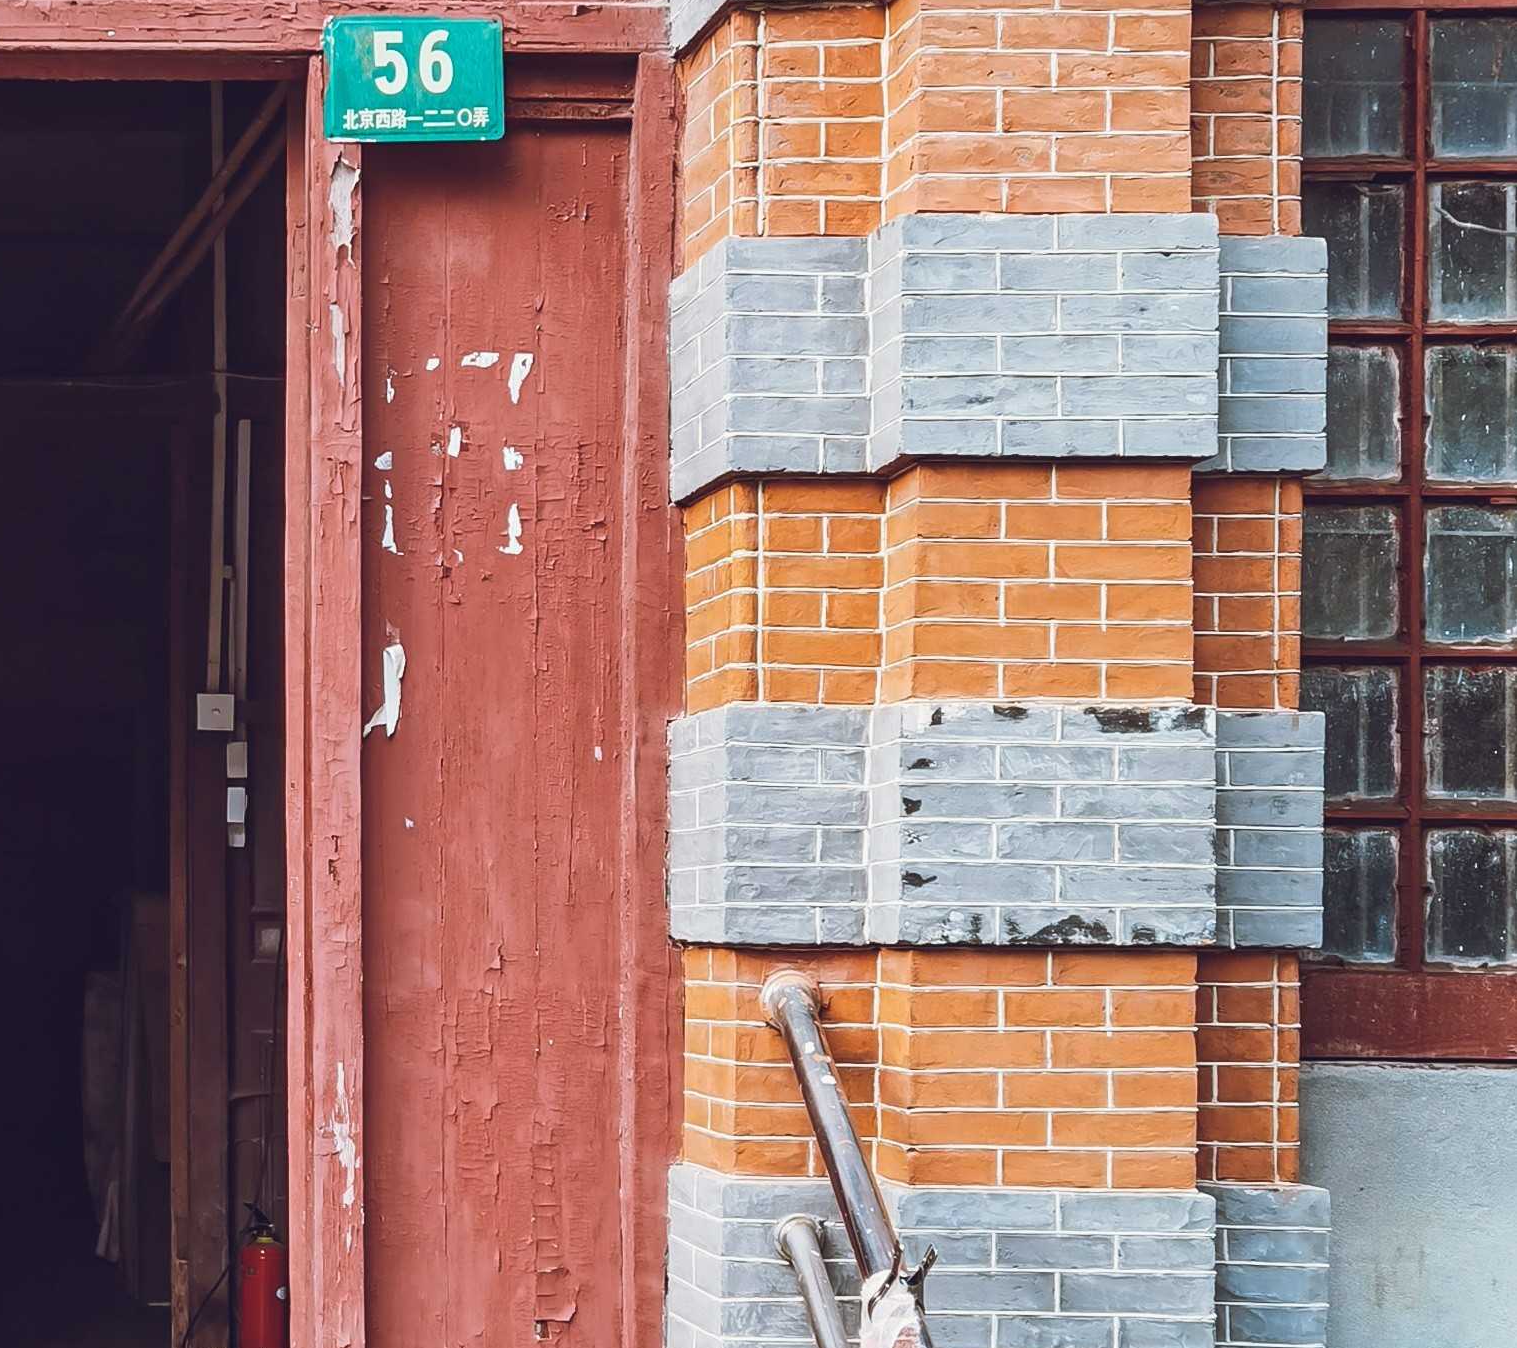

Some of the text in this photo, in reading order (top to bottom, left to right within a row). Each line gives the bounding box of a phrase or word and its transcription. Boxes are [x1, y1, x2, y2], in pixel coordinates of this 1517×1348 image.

[372, 29, 454, 96] 56
[343, 107, 490, 130] 北京西路一二二〇弄
